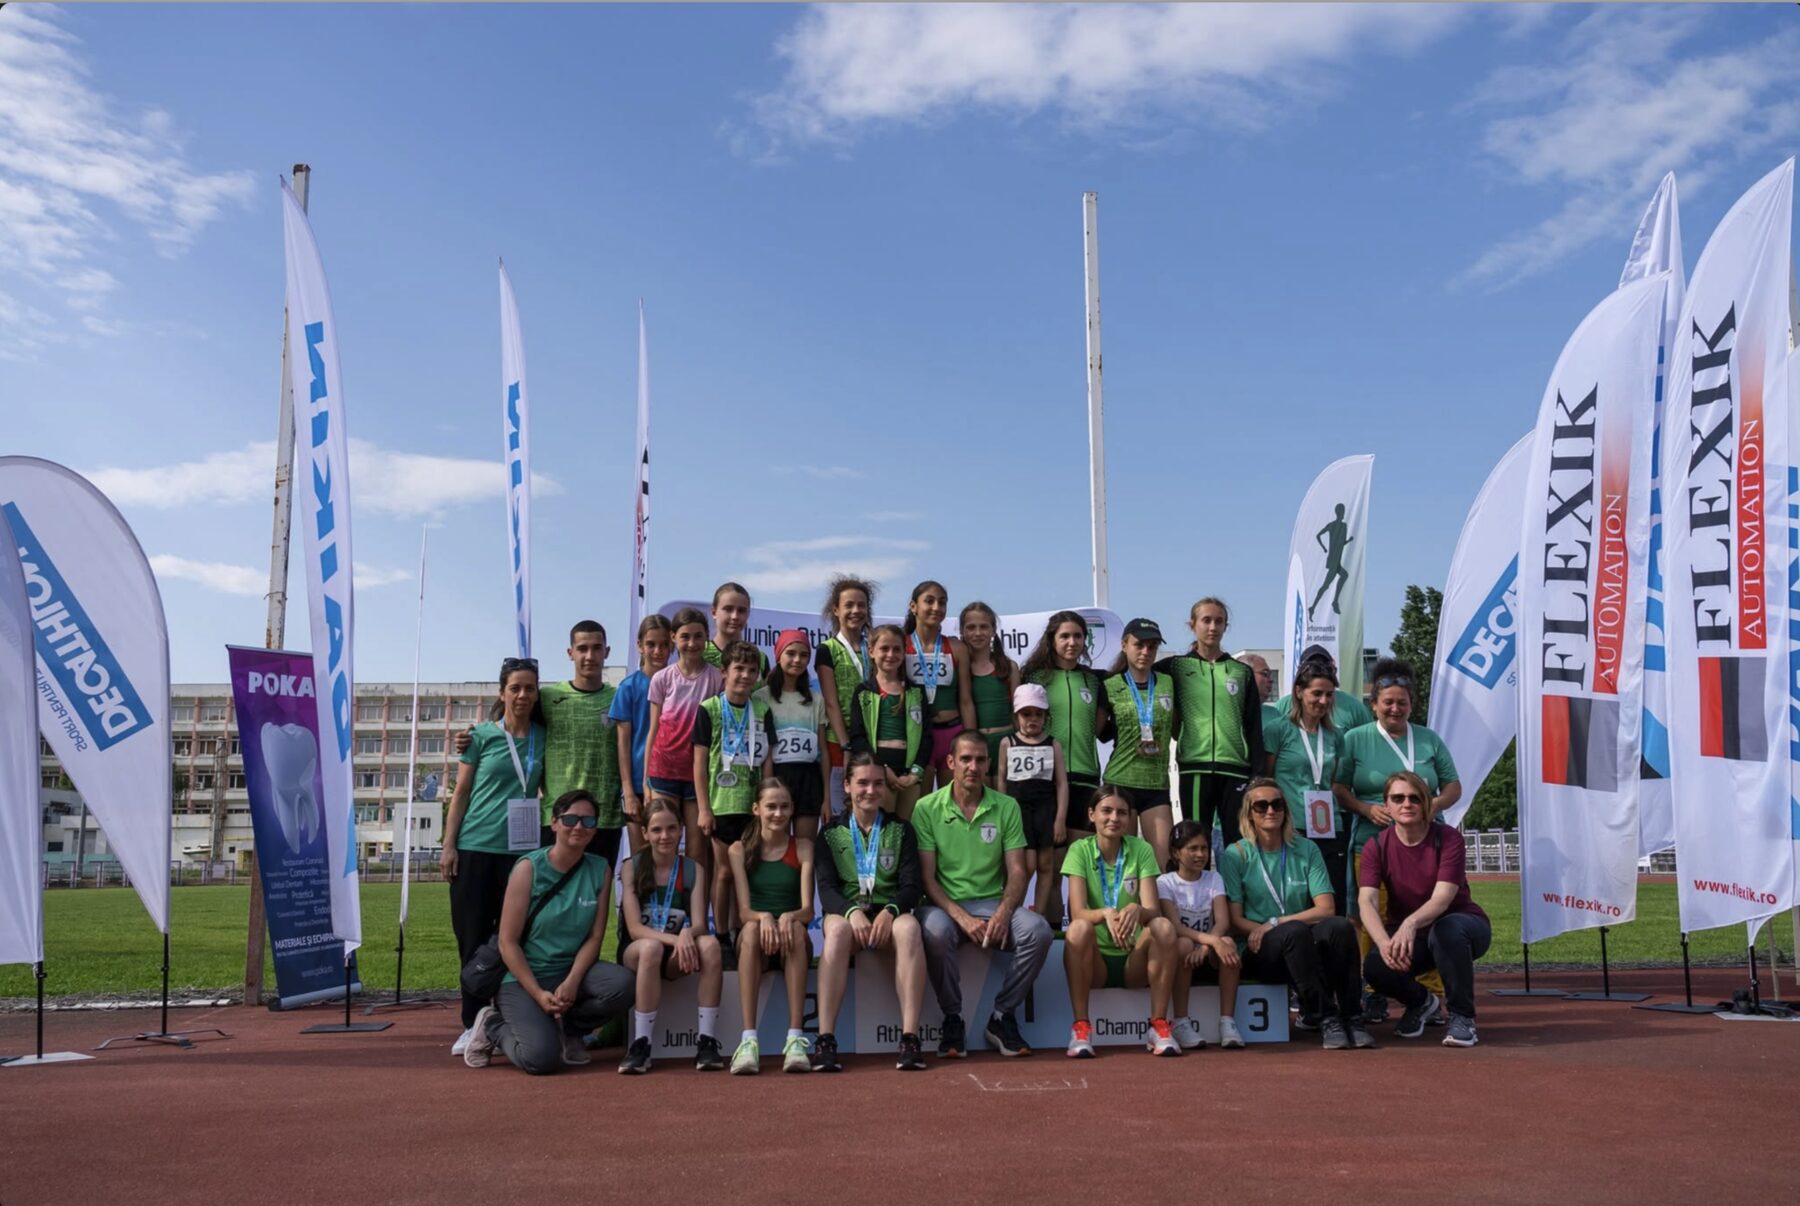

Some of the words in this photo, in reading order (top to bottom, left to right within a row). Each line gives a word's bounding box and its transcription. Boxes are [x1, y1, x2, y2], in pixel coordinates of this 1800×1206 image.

[1687, 300, 1736, 650] FLEXIK
[1542, 382, 1598, 692] FLEXIK
[1742, 418, 1763, 640] AUTOMATION
[1597, 494, 1622, 687] AUTOMATION
[913, 662, 947, 677] 233
[248, 671, 315, 698] POKA
[778, 738, 812, 755] 254
[1013, 756, 1044, 773] 261
[641, 914, 677, 931] 25
[275, 936, 306, 950] MATERIALE
[312, 932, 335, 944] ECHIPA
[1248, 998, 1269, 1031] 3
